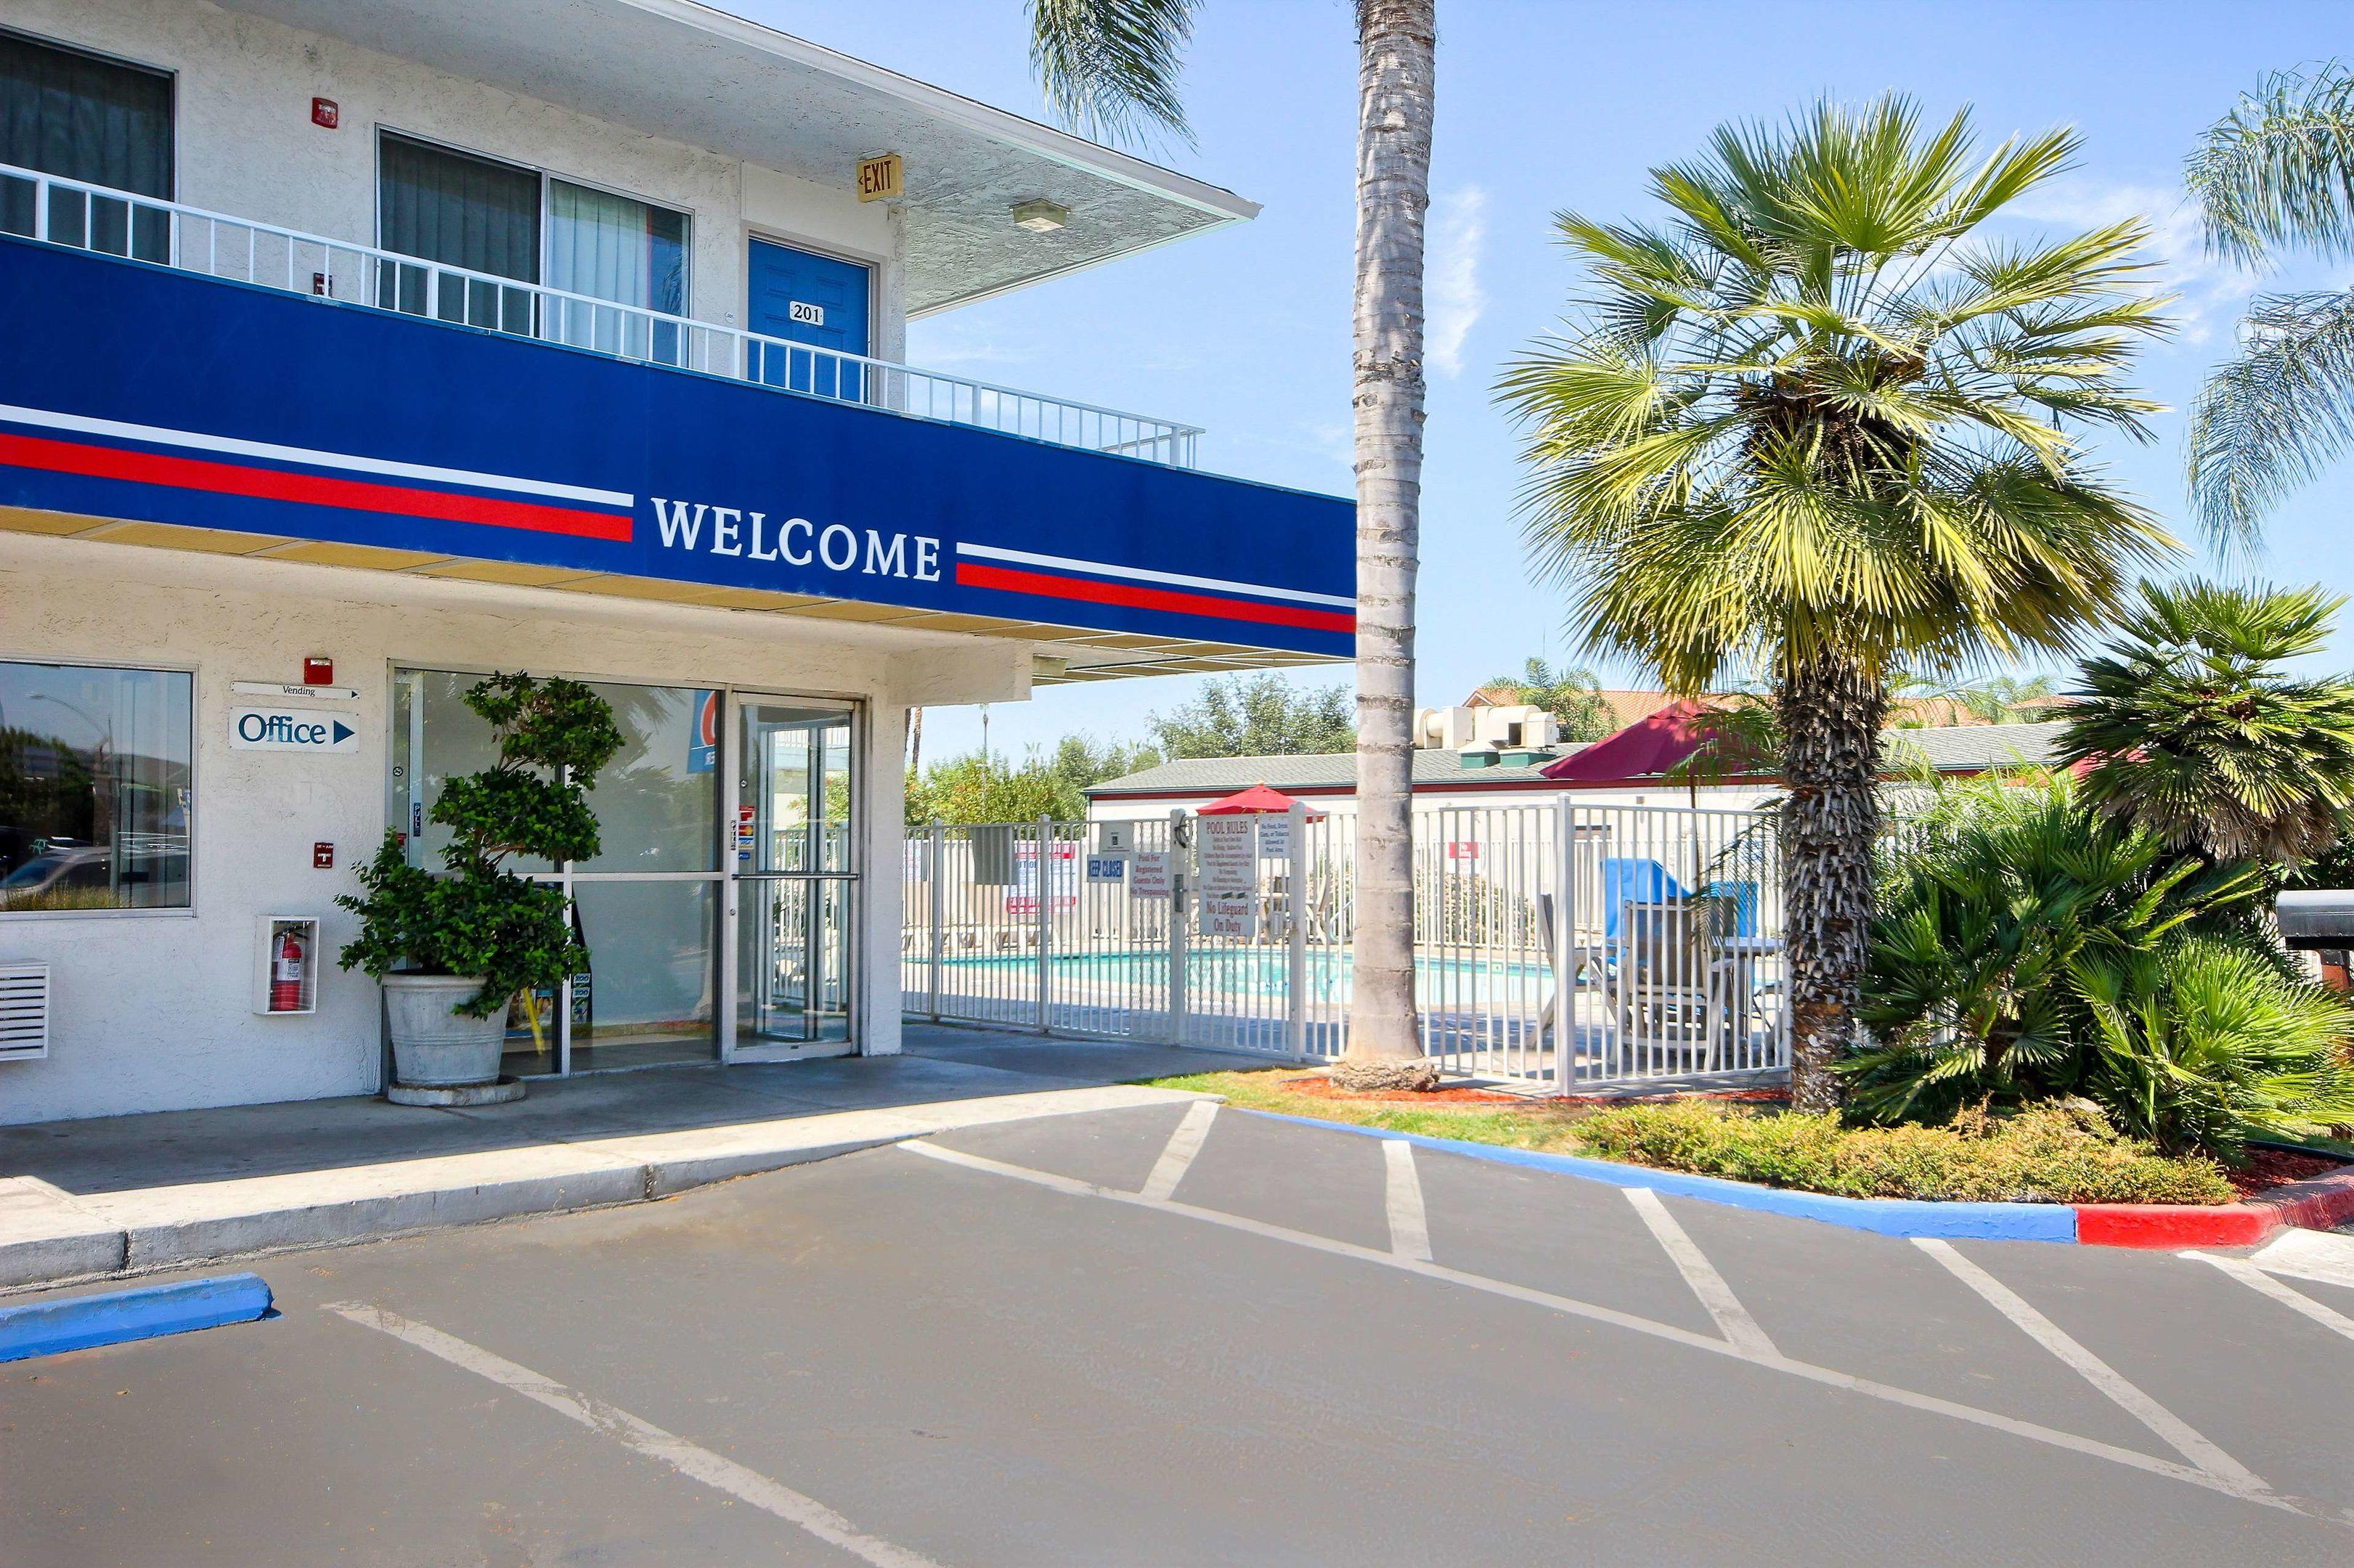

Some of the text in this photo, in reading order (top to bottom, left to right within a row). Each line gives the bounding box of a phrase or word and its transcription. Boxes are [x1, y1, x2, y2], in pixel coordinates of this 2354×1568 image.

[863, 160, 892, 194] EXIT
[794, 305, 819, 322] 201
[650, 497, 941, 582] WELCOME
[282, 685, 316, 697] Vending
[238, 713, 327, 745] Office
[1206, 820, 1248, 835] POOL RULES
[1103, 859, 1123, 878] CLOSED
[1136, 865, 1162, 874] Registered
[1152, 876, 1165, 886] Only
[1139, 888, 1170, 897] Trespassing
[1207, 901, 1248, 918] No Lifeguard
[1214, 918, 1241, 934] On Duty
